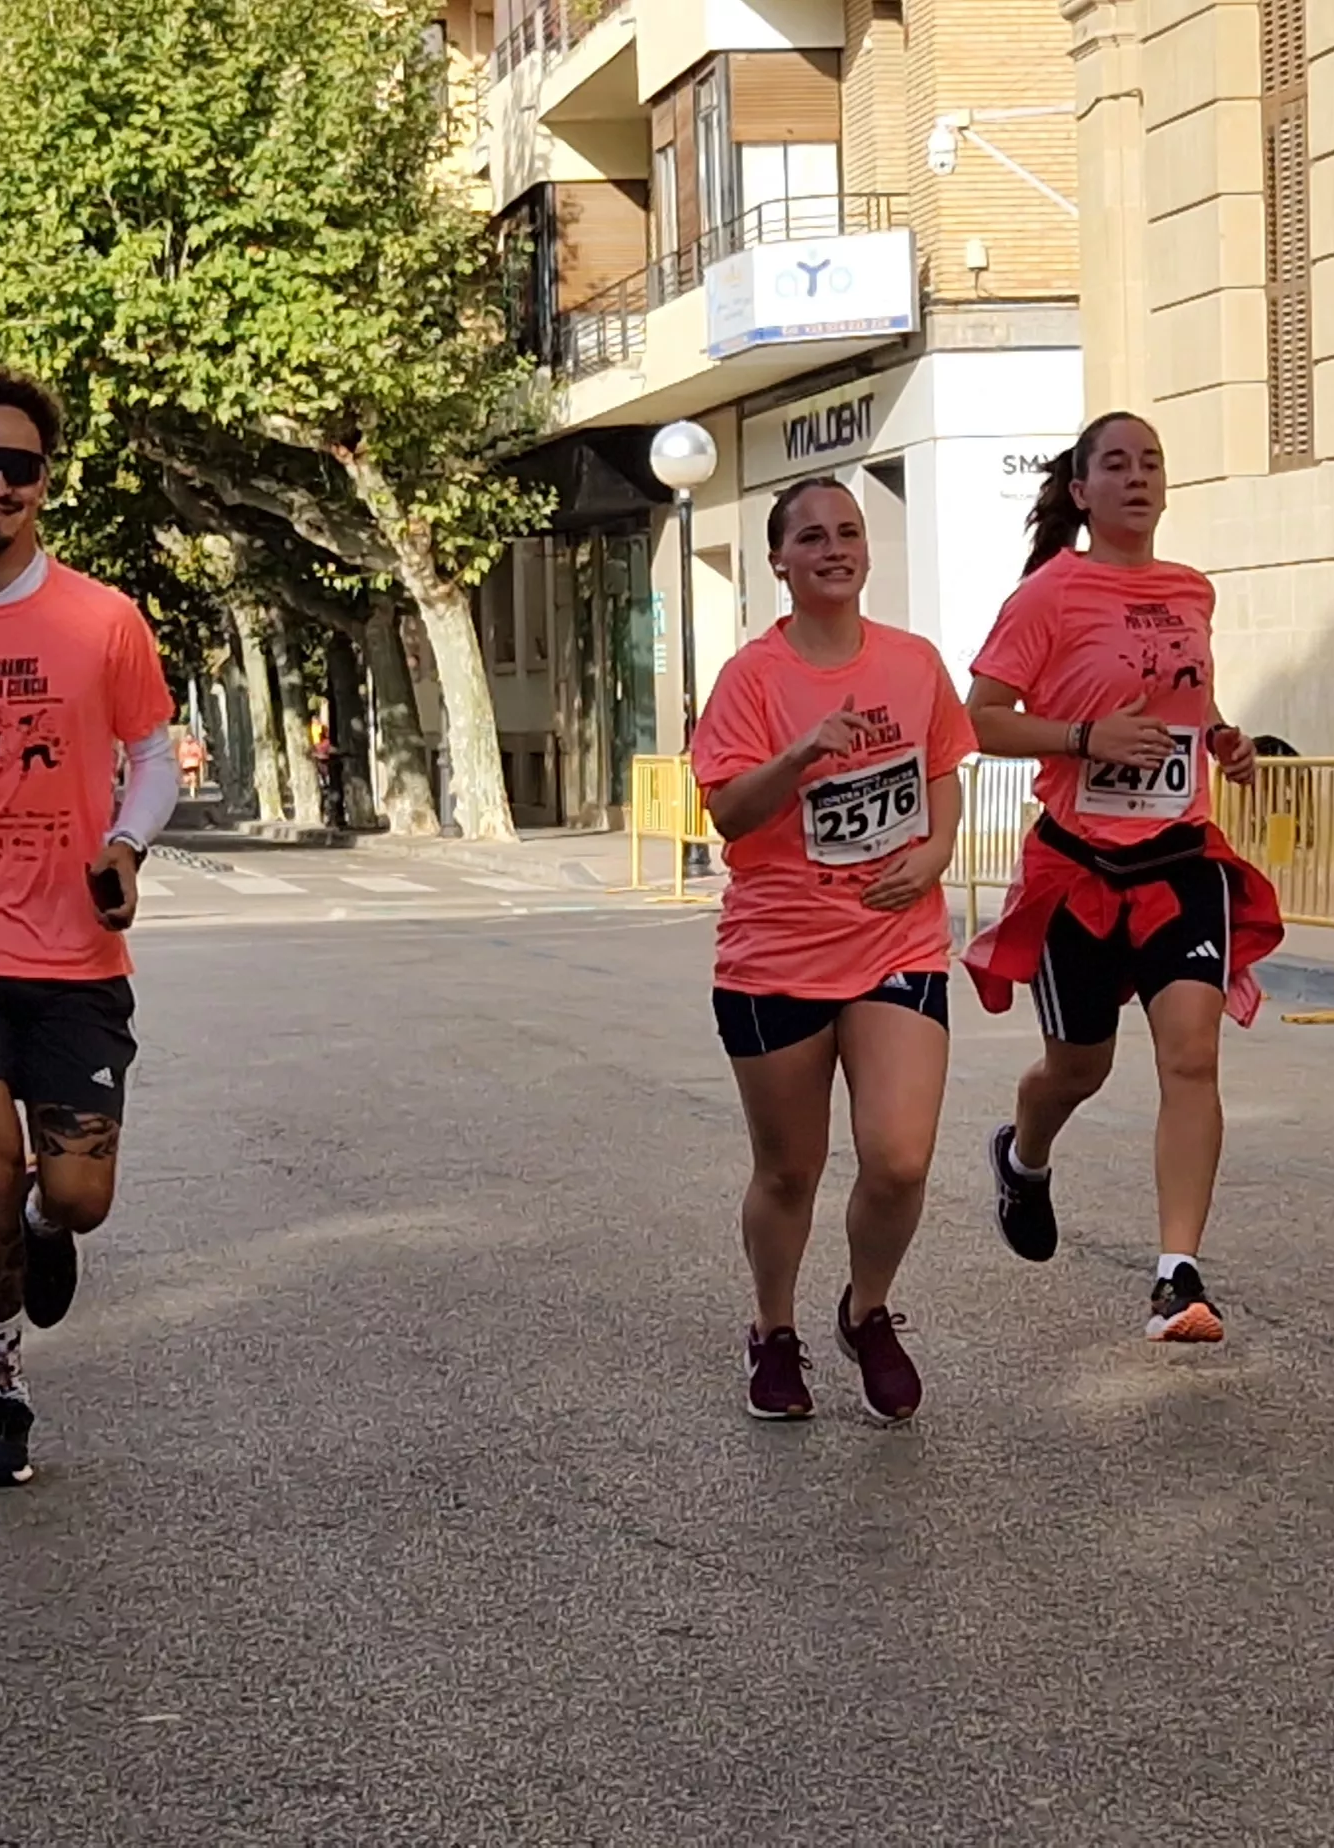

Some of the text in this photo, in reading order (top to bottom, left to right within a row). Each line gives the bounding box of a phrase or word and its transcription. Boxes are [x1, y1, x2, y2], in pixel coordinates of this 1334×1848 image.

[782, 391, 875, 461] VITALDENT
[1090, 758, 1186, 792] 2470
[817, 781, 915, 842] 2576
